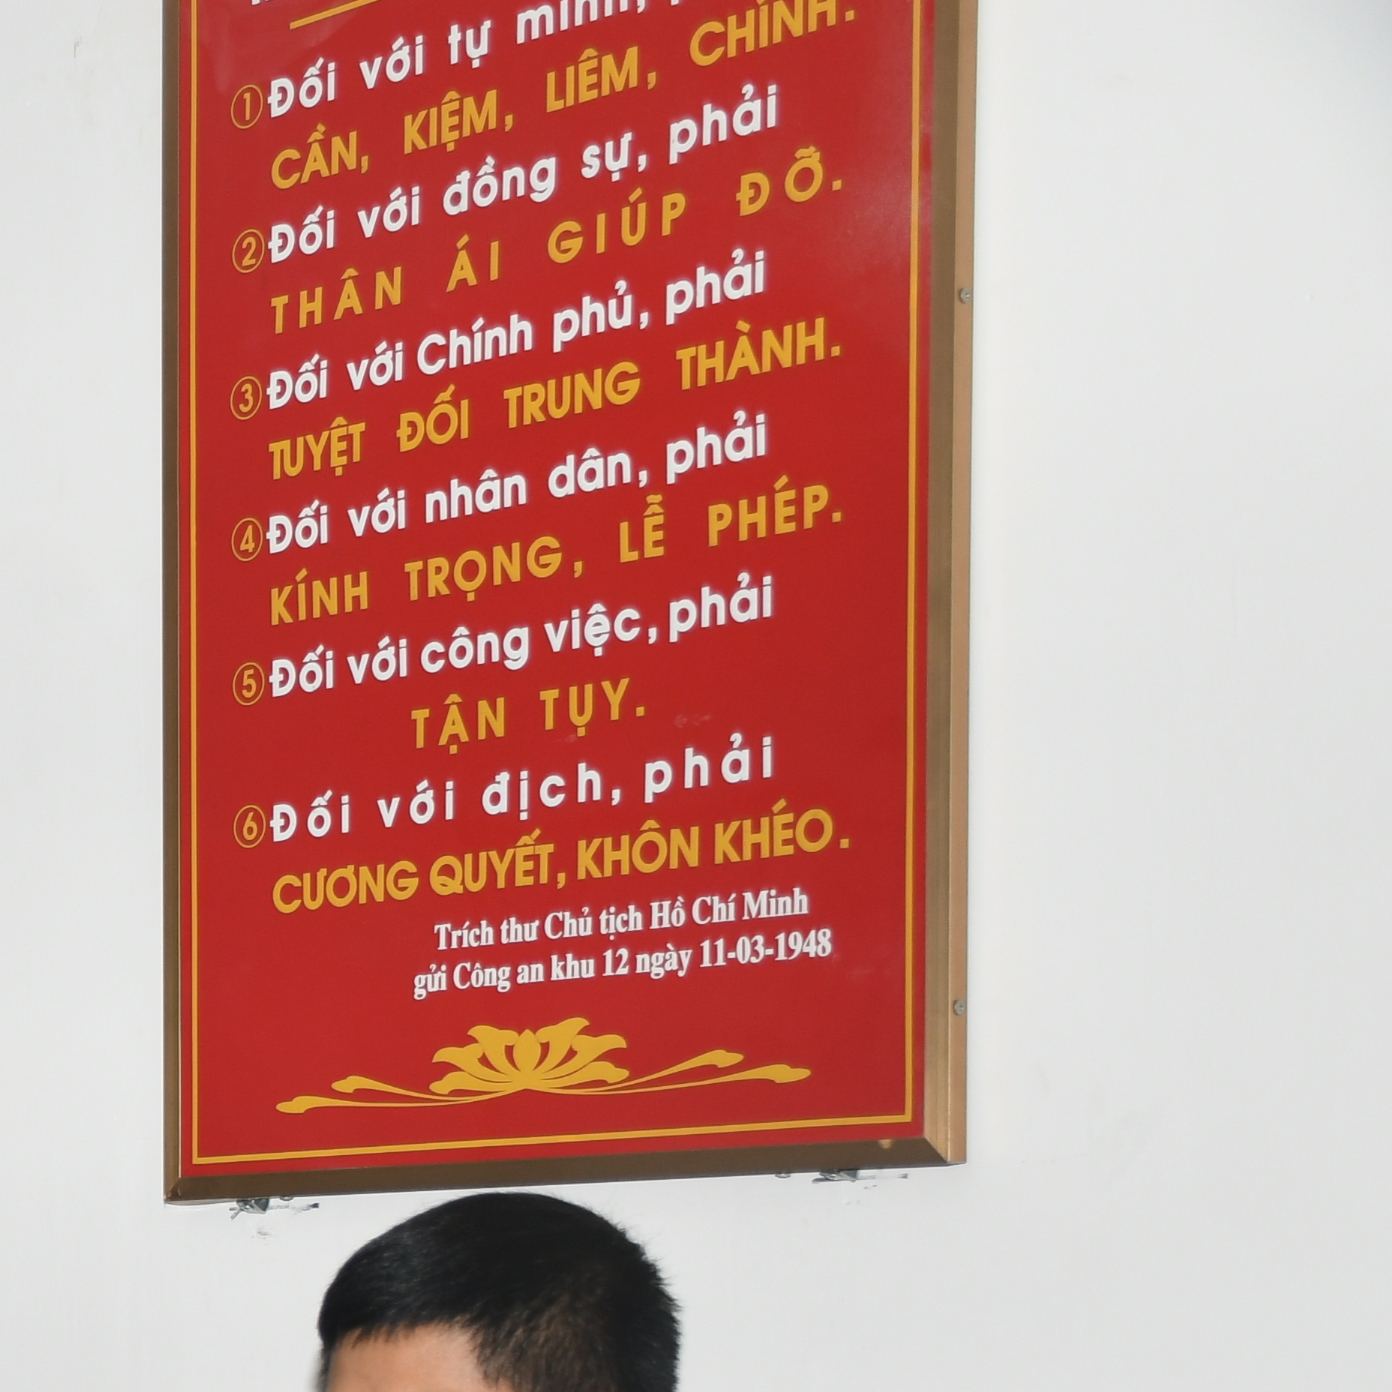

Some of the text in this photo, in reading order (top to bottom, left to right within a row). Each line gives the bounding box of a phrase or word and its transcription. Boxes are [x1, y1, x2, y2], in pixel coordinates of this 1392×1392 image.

[267, 56, 336, 118] Đối
[359, 34, 424, 90] với
[448, 19, 492, 67] tự
[271, 123, 369, 189] CẦN,
[404, 89, 513, 155] KIỆM,
[546, 46, 657, 113] LIÊM,
[267, 204, 335, 264] Đối
[357, 185, 420, 239] với
[443, 154, 557, 216] đồng
[580, 131, 648, 183] sự,
[669, 82, 778, 165] phải
[271, 145, 842, 334] THÂN ÁI GIÚP ĐỠ.
[265, 352, 328, 410] Đối
[346, 340, 404, 391] với
[416, 313, 534, 375] Chính
[552, 279, 650, 353] phủ,
[665, 247, 766, 326] phải
[269, 317, 840, 480] TUYỆT ĐỐI TRUNG THÀNH.
[265, 498, 329, 554] Đối
[347, 487, 406, 537] với
[425, 468, 528, 524] nhân
[548, 446, 649, 498] dân,
[666, 409, 767, 485] phải
[271, 474, 842, 626] KÍNH TRỌNG, LỄ PHÉP.
[268, 644, 334, 698] Đối
[346, 635, 408, 685] với
[420, 625, 530, 674] công
[544, 602, 658, 657] việc,
[669, 571, 773, 643] phải
[411, 677, 645, 755] TẬN TỤY.
[269, 789, 350, 843] Đối
[377, 779, 454, 828] với
[481, 762, 622, 821] địch,
[644, 732, 773, 804] phải
[272, 798, 850, 914] CƯƠNG QUYẾT, KHÔN KHÉO.
[433, 886, 809, 951] Trích thư Chủ tịch Hồ Chí Minh
[413, 928, 833, 1001] gửi Công an khu 12 ngày 11-03-1948
